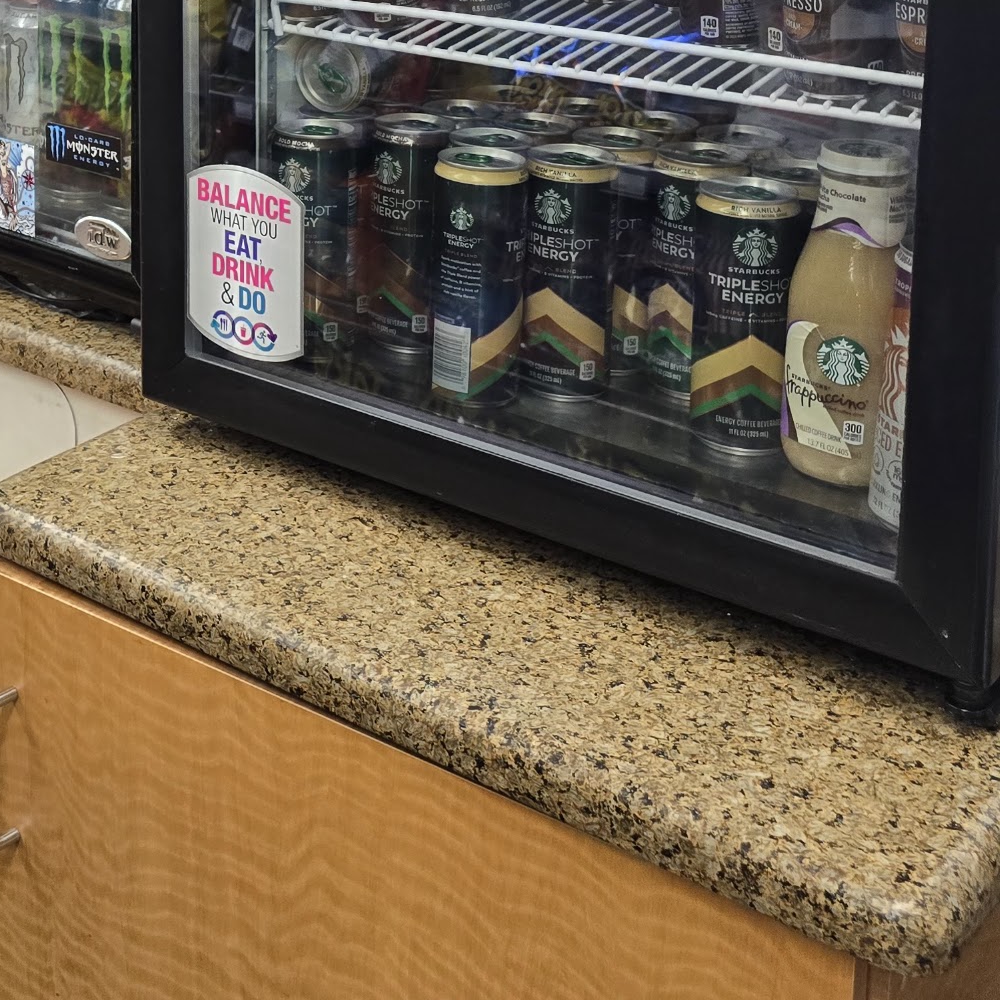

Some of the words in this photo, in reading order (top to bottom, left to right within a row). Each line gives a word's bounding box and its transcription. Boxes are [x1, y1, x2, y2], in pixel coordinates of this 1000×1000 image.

[895, 2, 926, 24] ESPR
[702, 18, 717, 28] 140
[769, 29, 781, 42] 140
[66, 139, 120, 163] MONSTER
[291, 140, 316, 148] MOCHA
[73, 154, 111, 168] ENERGY
[197, 177, 292, 225] BALANCE
[373, 192, 425, 211] PLESHOT
[830, 188, 867, 204] Chocolate
[731, 205, 750, 214] RICH
[751, 206, 782, 214] VANILLA
[210, 206, 248, 229] WHAT
[252, 217, 278, 240] YOU
[532, 221, 575, 235] STARBUCKS
[443, 231, 481, 244] TRIPLESHOT
[447, 239, 474, 249] ENERGY
[529, 232, 594, 251] IPLESHOT
[223, 230, 263, 265] EAT,
[528, 242, 580, 263] ENERGY
[652, 238, 695, 260] ENERGY
[212, 252, 274, 292] DRINK
[555, 267, 577, 275] BLEND
[728, 266, 780, 276] STARBUCKS
[708, 271, 790, 292] TRIPLESHO
[895, 277, 912, 293] TROPI
[221, 281, 235, 307] &
[238, 287, 266, 315] DO
[721, 289, 785, 305] ENERGY
[325, 324, 336, 333] 150
[414, 316, 426, 325] 150
[626, 338, 637, 347] 150
[535, 362, 551, 372] COFFEE
[551, 366, 576, 377] BEVERAGE
[582, 362, 593, 371] 150
[785, 363, 867, 412] frappuccino
[791, 372, 830, 392] STARBUCKS
[715, 415, 736, 425] ENERGY
[736, 417, 757, 428] COFFEE
[844, 422, 862, 434] 300
[747, 430, 759, 438] (325
[796, 422, 811, 433] CHILLED
[811, 426, 827, 438] COFFEE
[826, 433, 842, 444] DRINK
[807, 437, 818, 447] 13.7
[826, 443, 834, 452] OZ
[834, 445, 849, 456] (405
